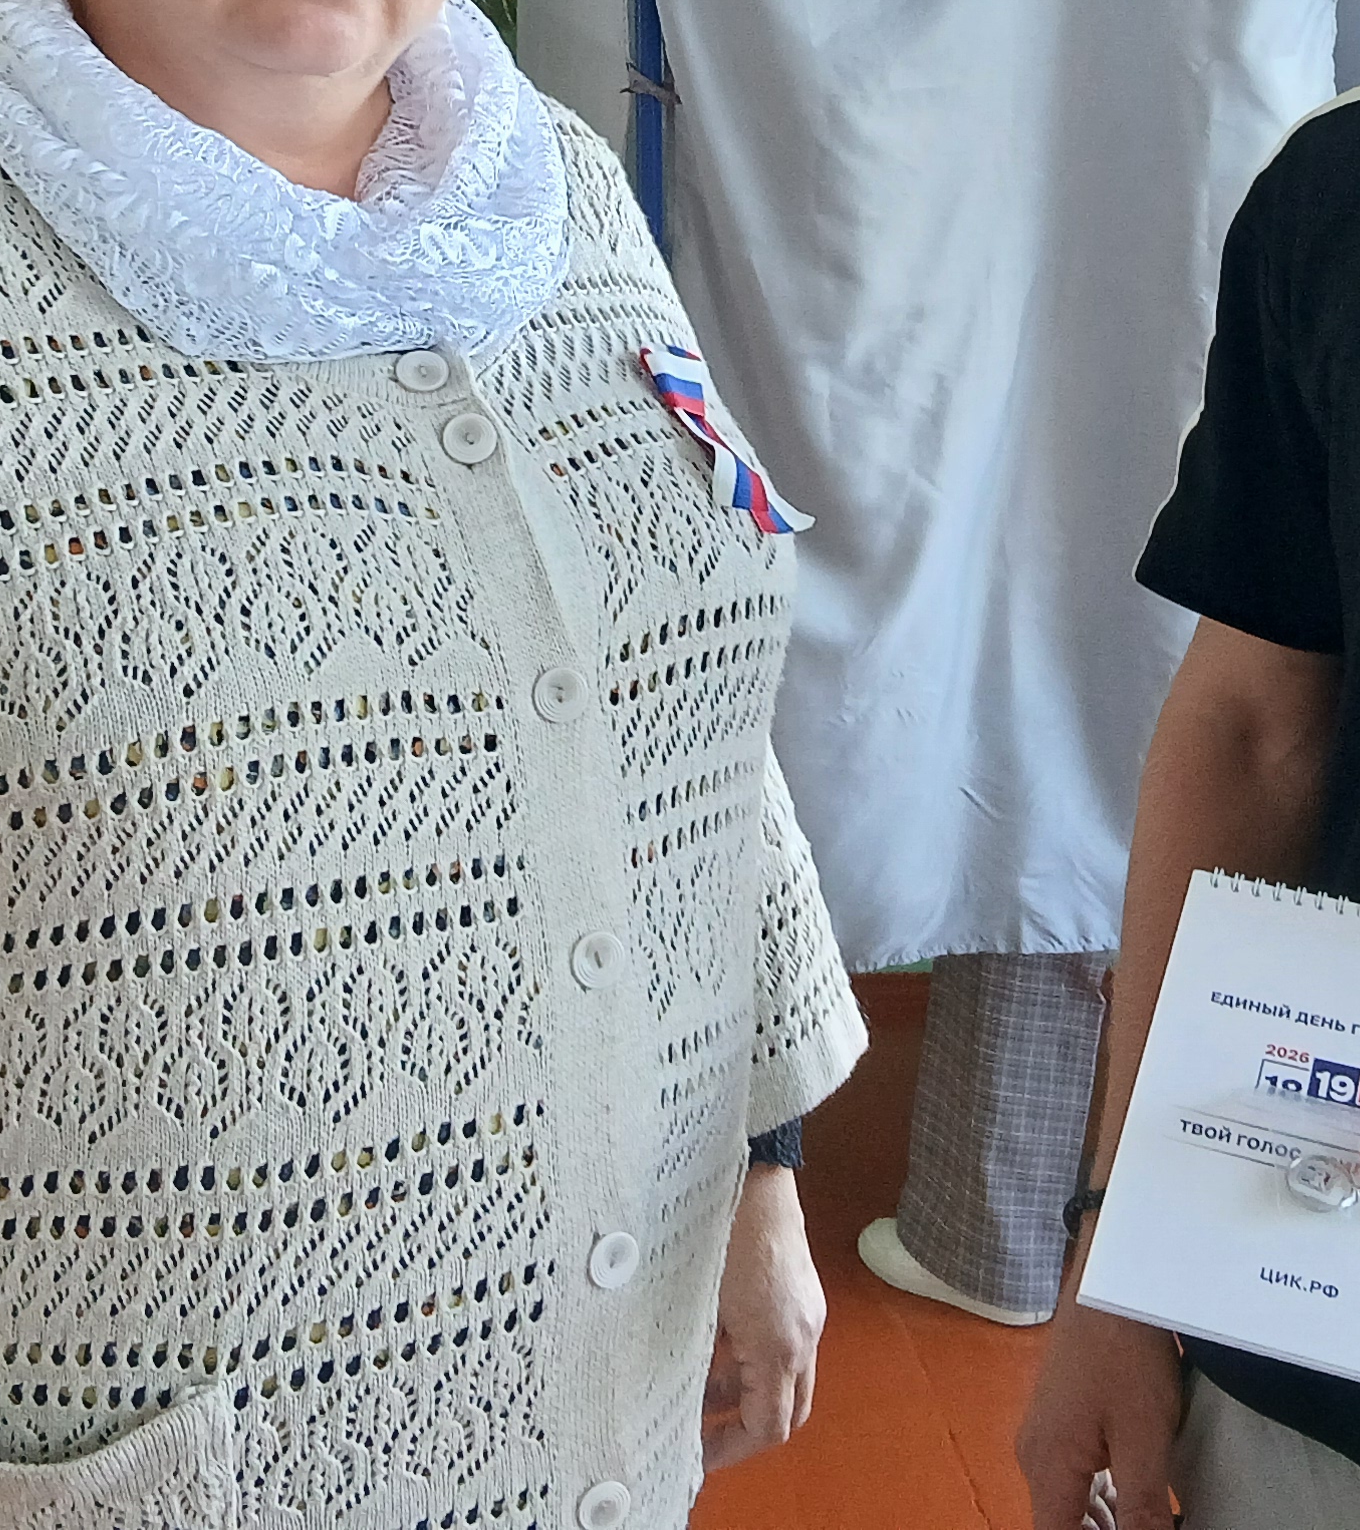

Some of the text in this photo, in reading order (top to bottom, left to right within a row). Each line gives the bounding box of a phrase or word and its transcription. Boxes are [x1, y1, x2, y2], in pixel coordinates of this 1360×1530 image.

[1210, 991, 1291, 1020] ЕДИНЫЙ
[1295, 1011, 1346, 1033] ДЕНЬ
[1265, 1044, 1310, 1064] 2026
[1315, 1070, 1356, 1104] 19
[1180, 1119, 1302, 1160] ТВОЙ ГОЛОС
[1259, 1267, 1340, 1299] ЦИК.РФ
